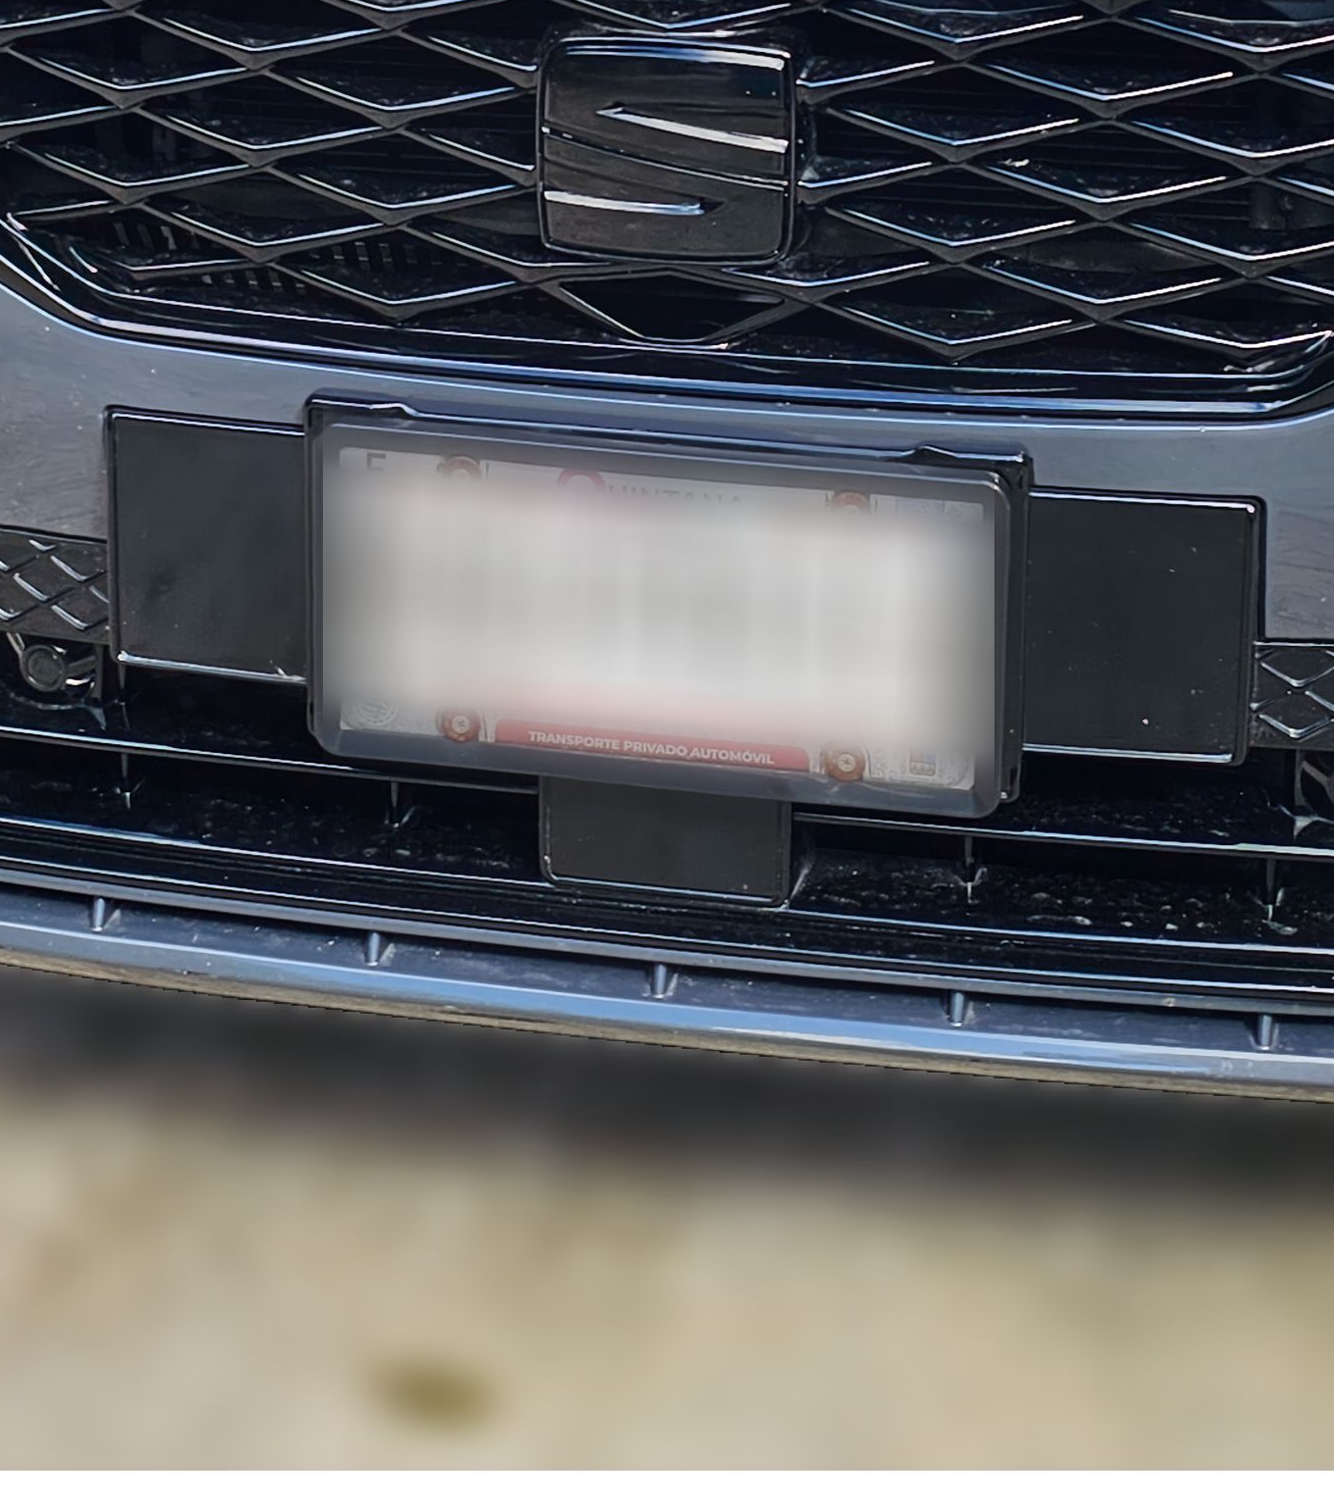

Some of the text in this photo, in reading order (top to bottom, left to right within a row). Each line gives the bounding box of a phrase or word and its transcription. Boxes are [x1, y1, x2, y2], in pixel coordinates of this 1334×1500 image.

[528, 730, 775, 765] TRANSPORTE PRIVADO AUTOMÓVIL
